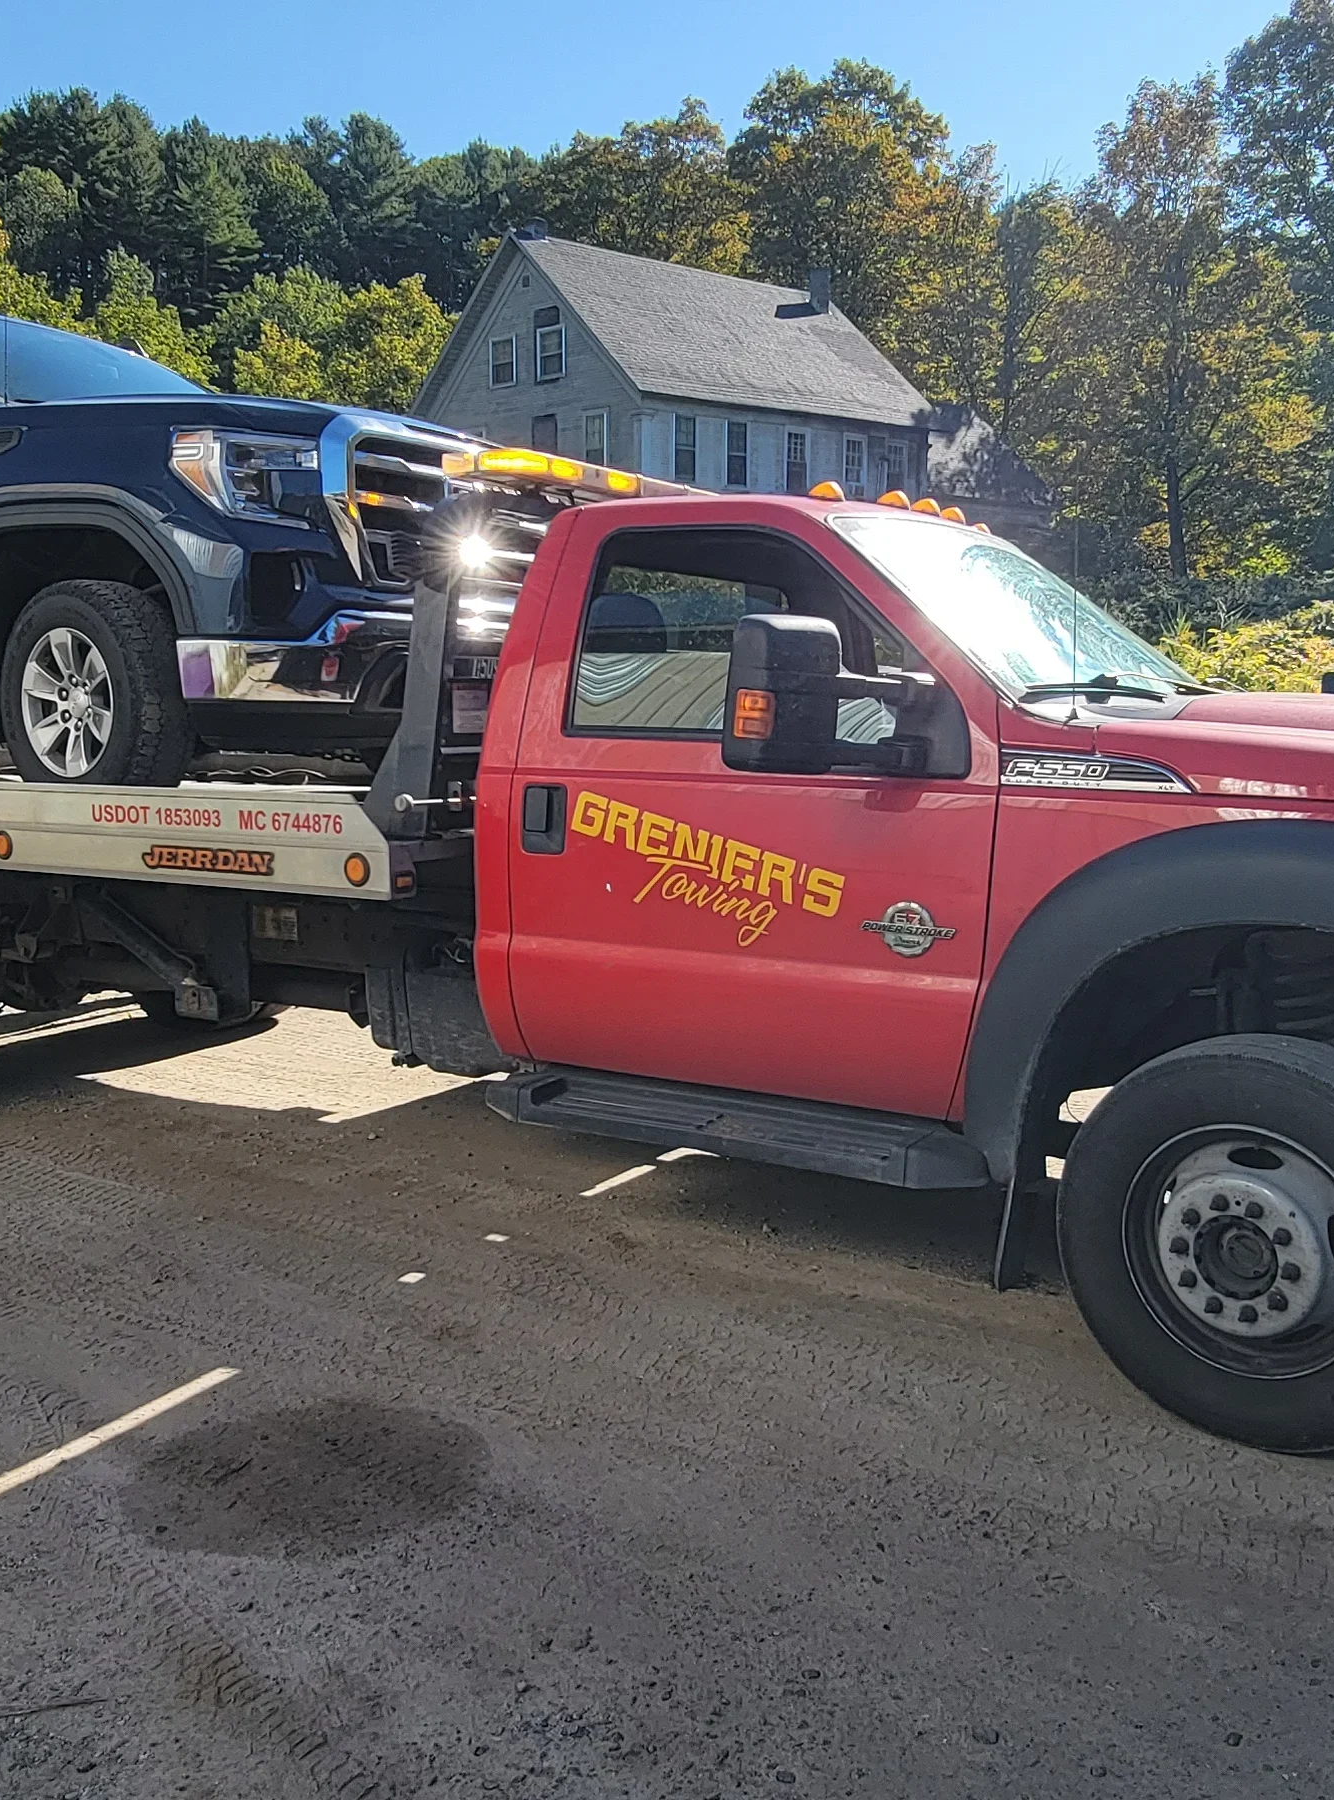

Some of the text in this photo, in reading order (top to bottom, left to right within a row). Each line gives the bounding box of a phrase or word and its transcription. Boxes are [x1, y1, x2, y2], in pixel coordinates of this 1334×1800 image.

[91, 804, 343, 834] USDOT 1853093 MC 6744876
[571, 790, 845, 918] GRENIER'S
[633, 857, 777, 947] Towing
